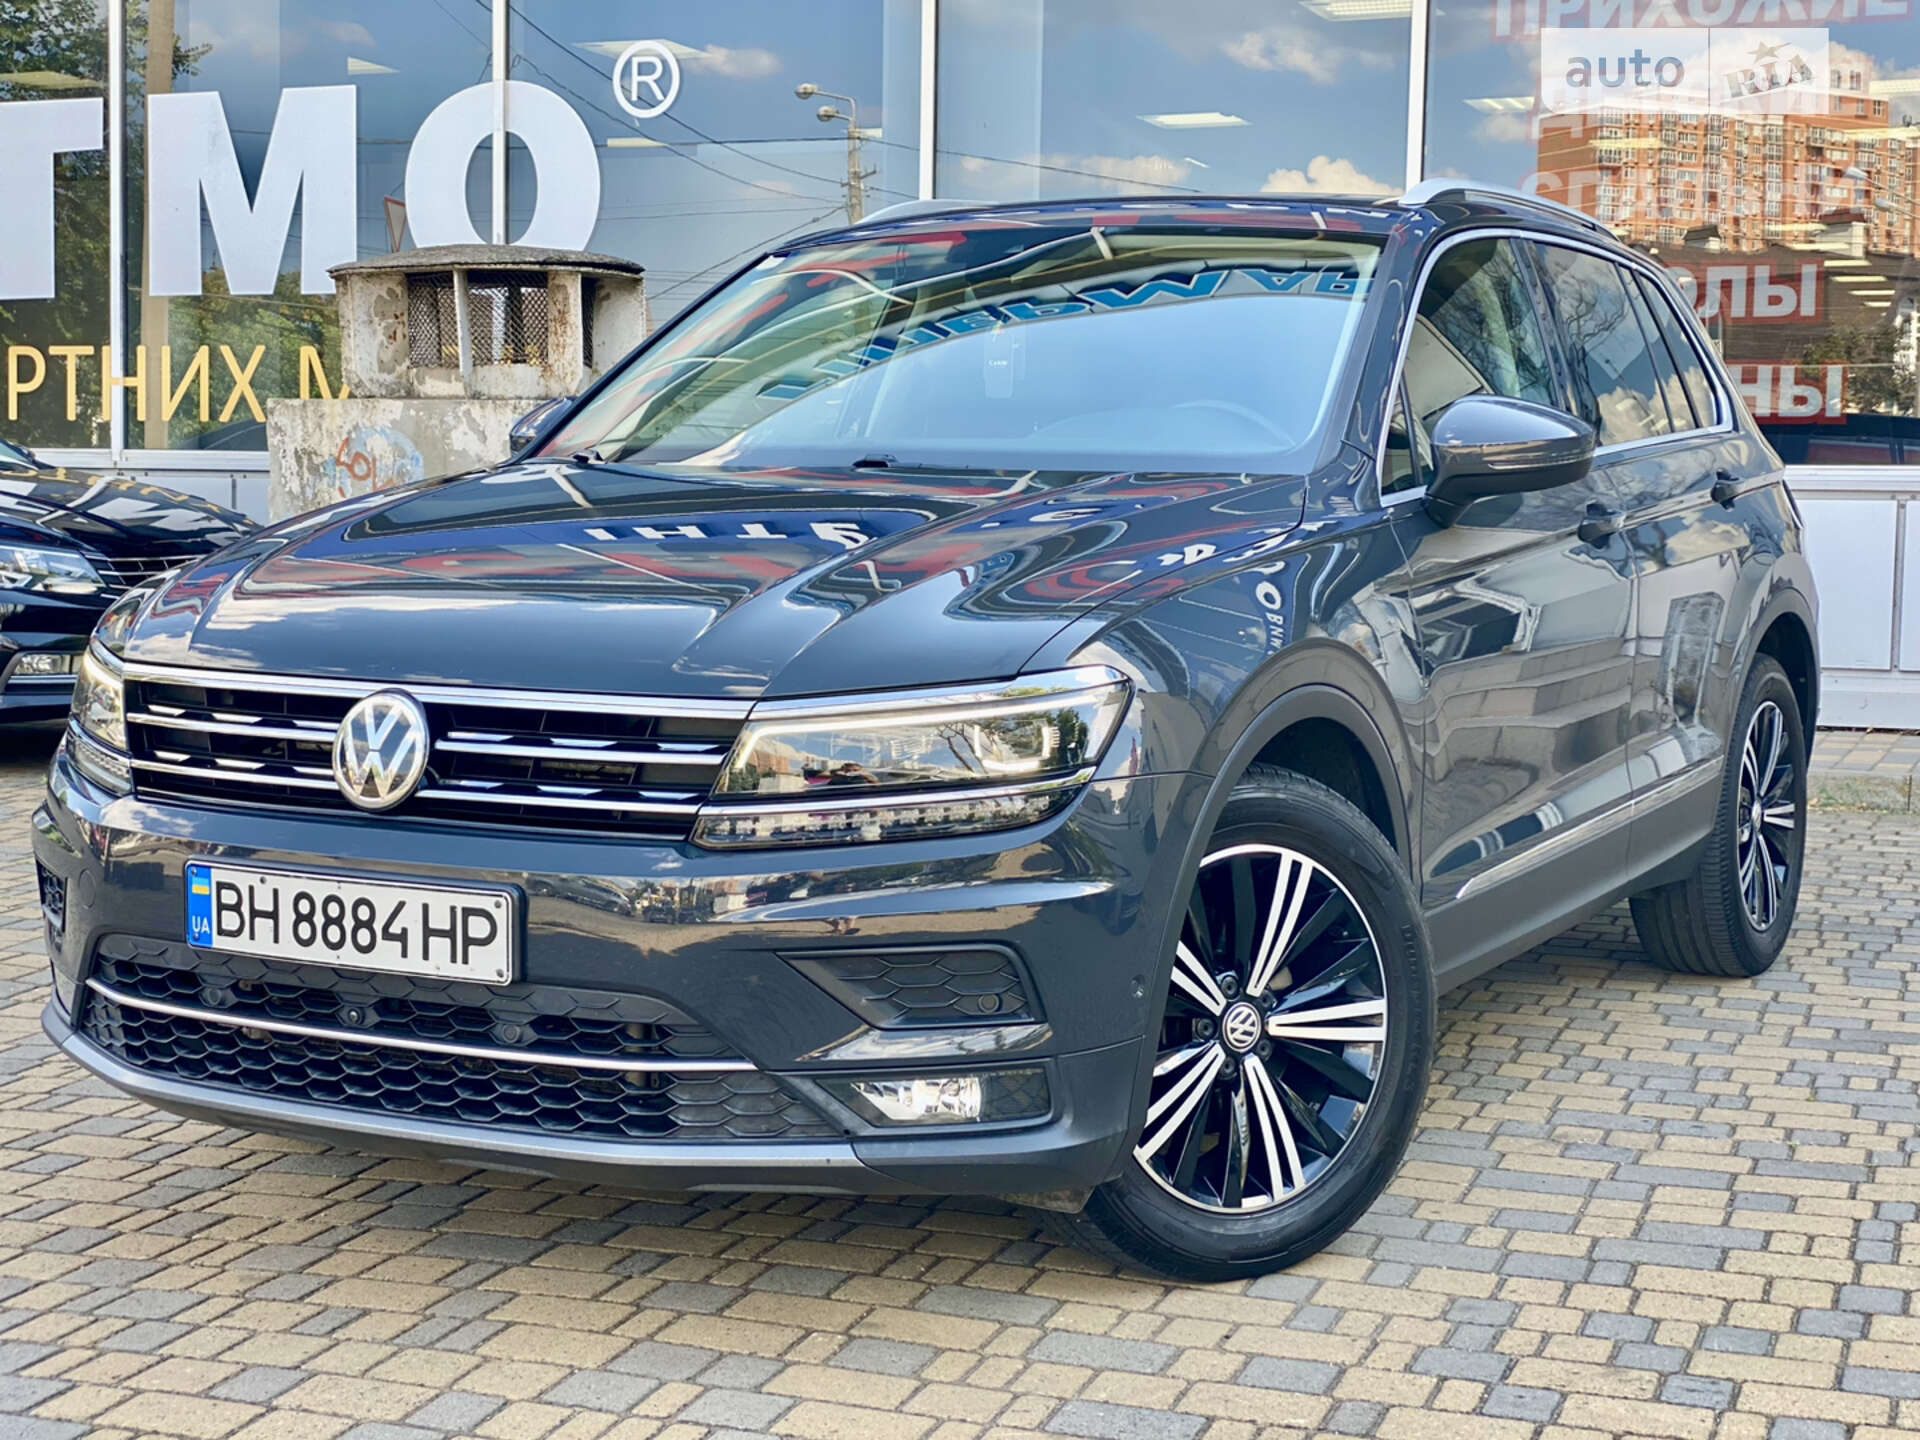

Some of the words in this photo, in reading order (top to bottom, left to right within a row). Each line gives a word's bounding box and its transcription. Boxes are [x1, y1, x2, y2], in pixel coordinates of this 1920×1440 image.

[8, 345, 267, 422] РТНИХ
[192, 915, 210, 934] UA
[215, 880, 279, 944] BH
[292, 891, 408, 958] 8884
[422, 902, 498, 965] HP
